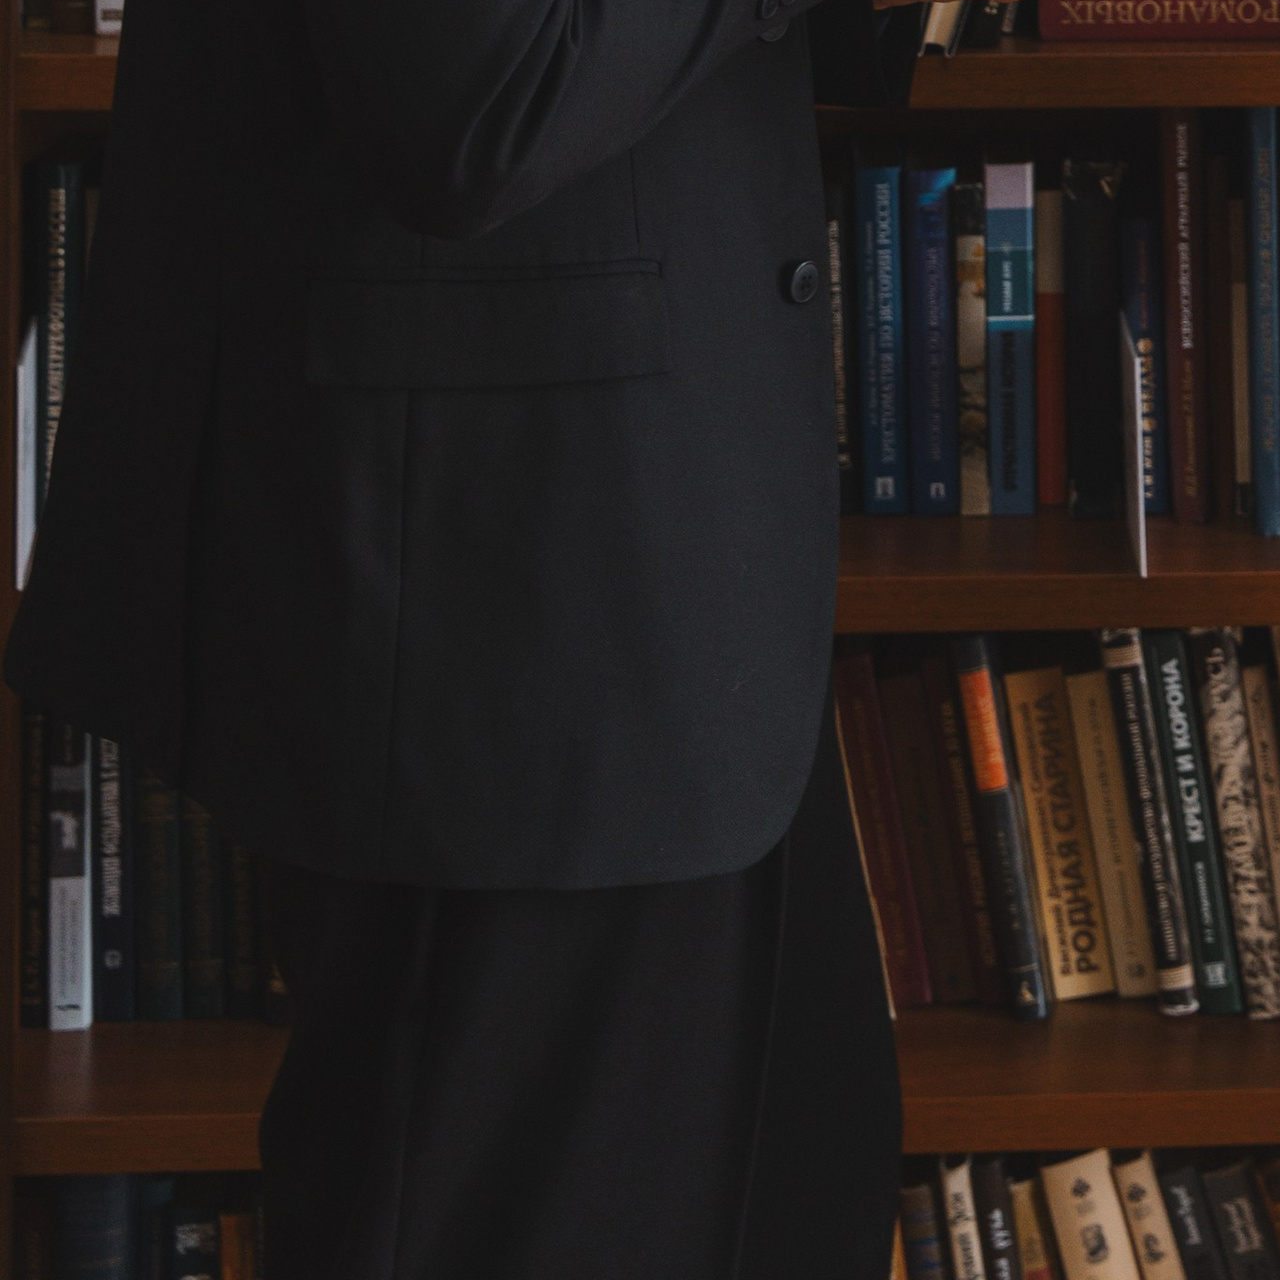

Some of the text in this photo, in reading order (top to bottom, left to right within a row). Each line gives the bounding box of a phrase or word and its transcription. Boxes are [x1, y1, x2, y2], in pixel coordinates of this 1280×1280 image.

[876, 182, 891, 246] РОССИИ
[877, 248, 893, 322] ИСТОРИИ
[1159, 657, 1205, 843] КРЕСТ И КОРОНА
[1032, 691, 1101, 975] РОДНАЯ СТАРИНА
